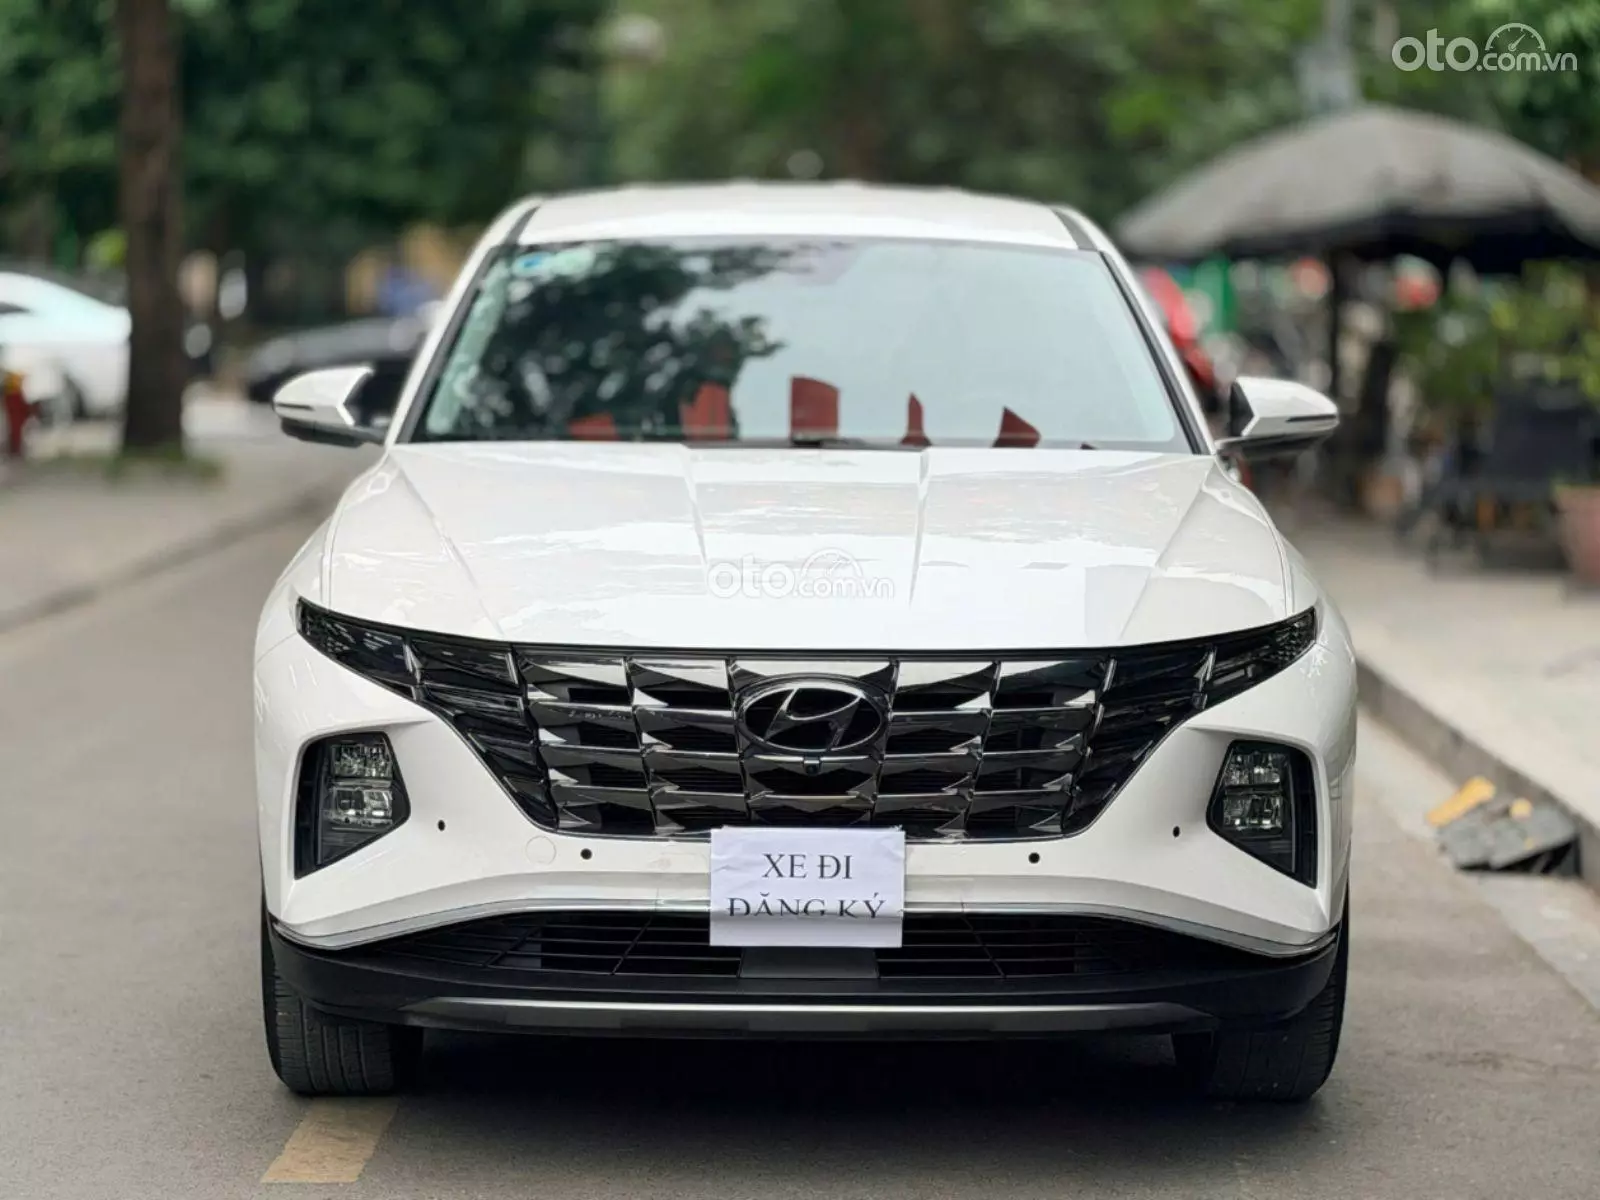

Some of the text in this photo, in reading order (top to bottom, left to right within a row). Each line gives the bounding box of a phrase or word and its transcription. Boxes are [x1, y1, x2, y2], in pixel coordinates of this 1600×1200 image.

[762, 853, 853, 880] XE ĐI
[726, 891, 887, 919] ĐĂNG KÝ
